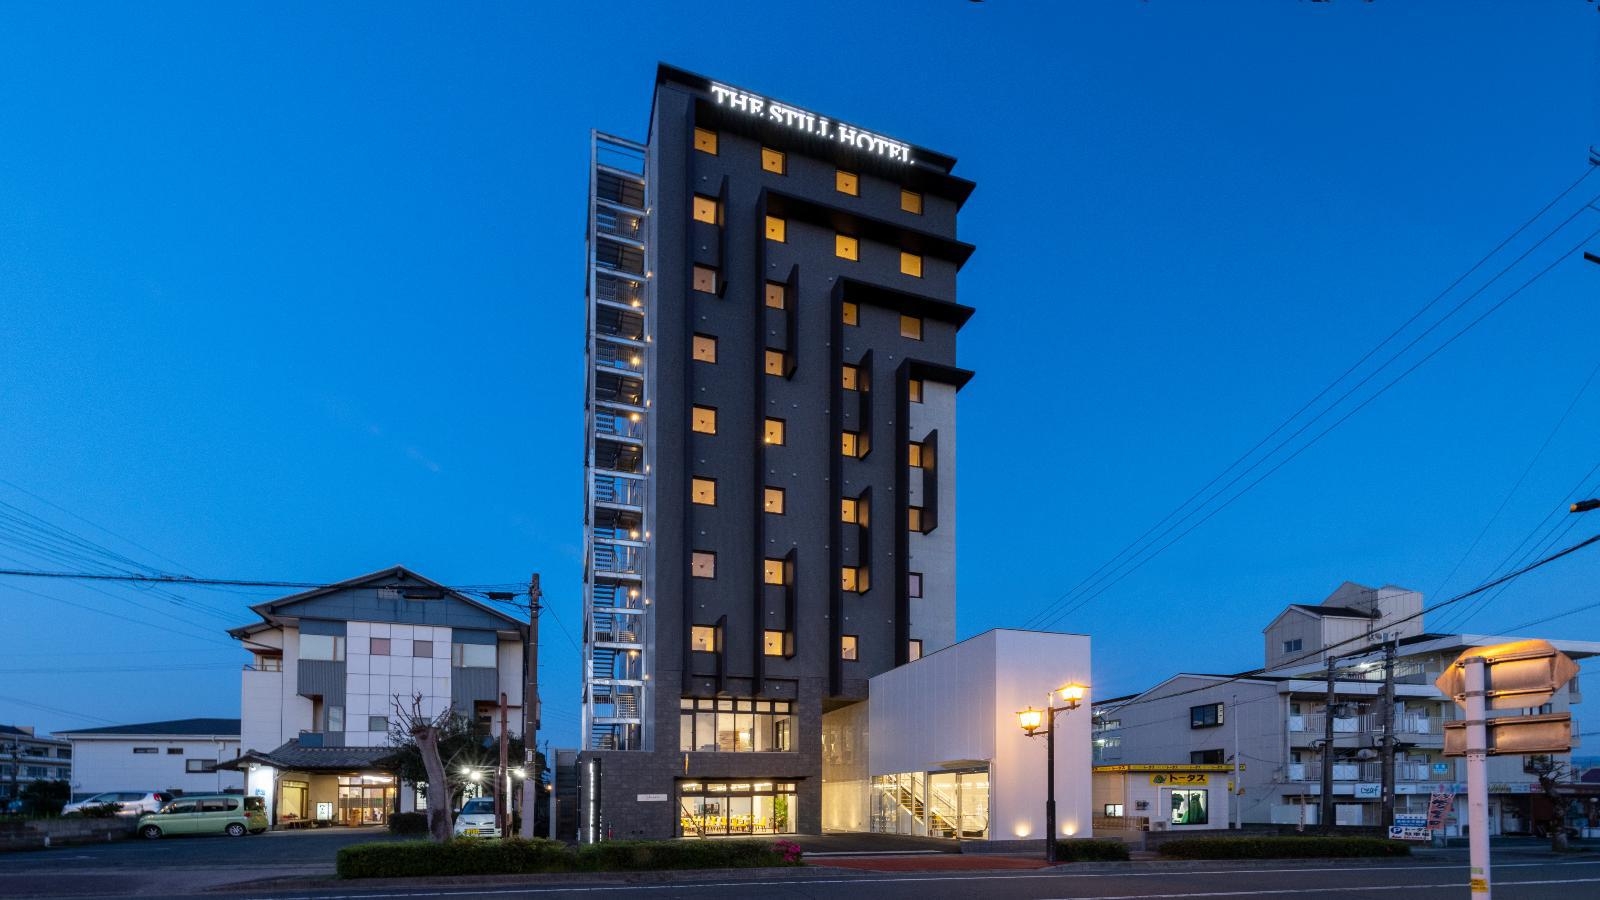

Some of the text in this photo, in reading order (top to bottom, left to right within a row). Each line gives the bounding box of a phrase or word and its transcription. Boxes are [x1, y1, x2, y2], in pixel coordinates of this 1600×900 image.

[711, 86, 916, 165] THE STILL HOTEL
[1169, 774, 1206, 782] トータス
